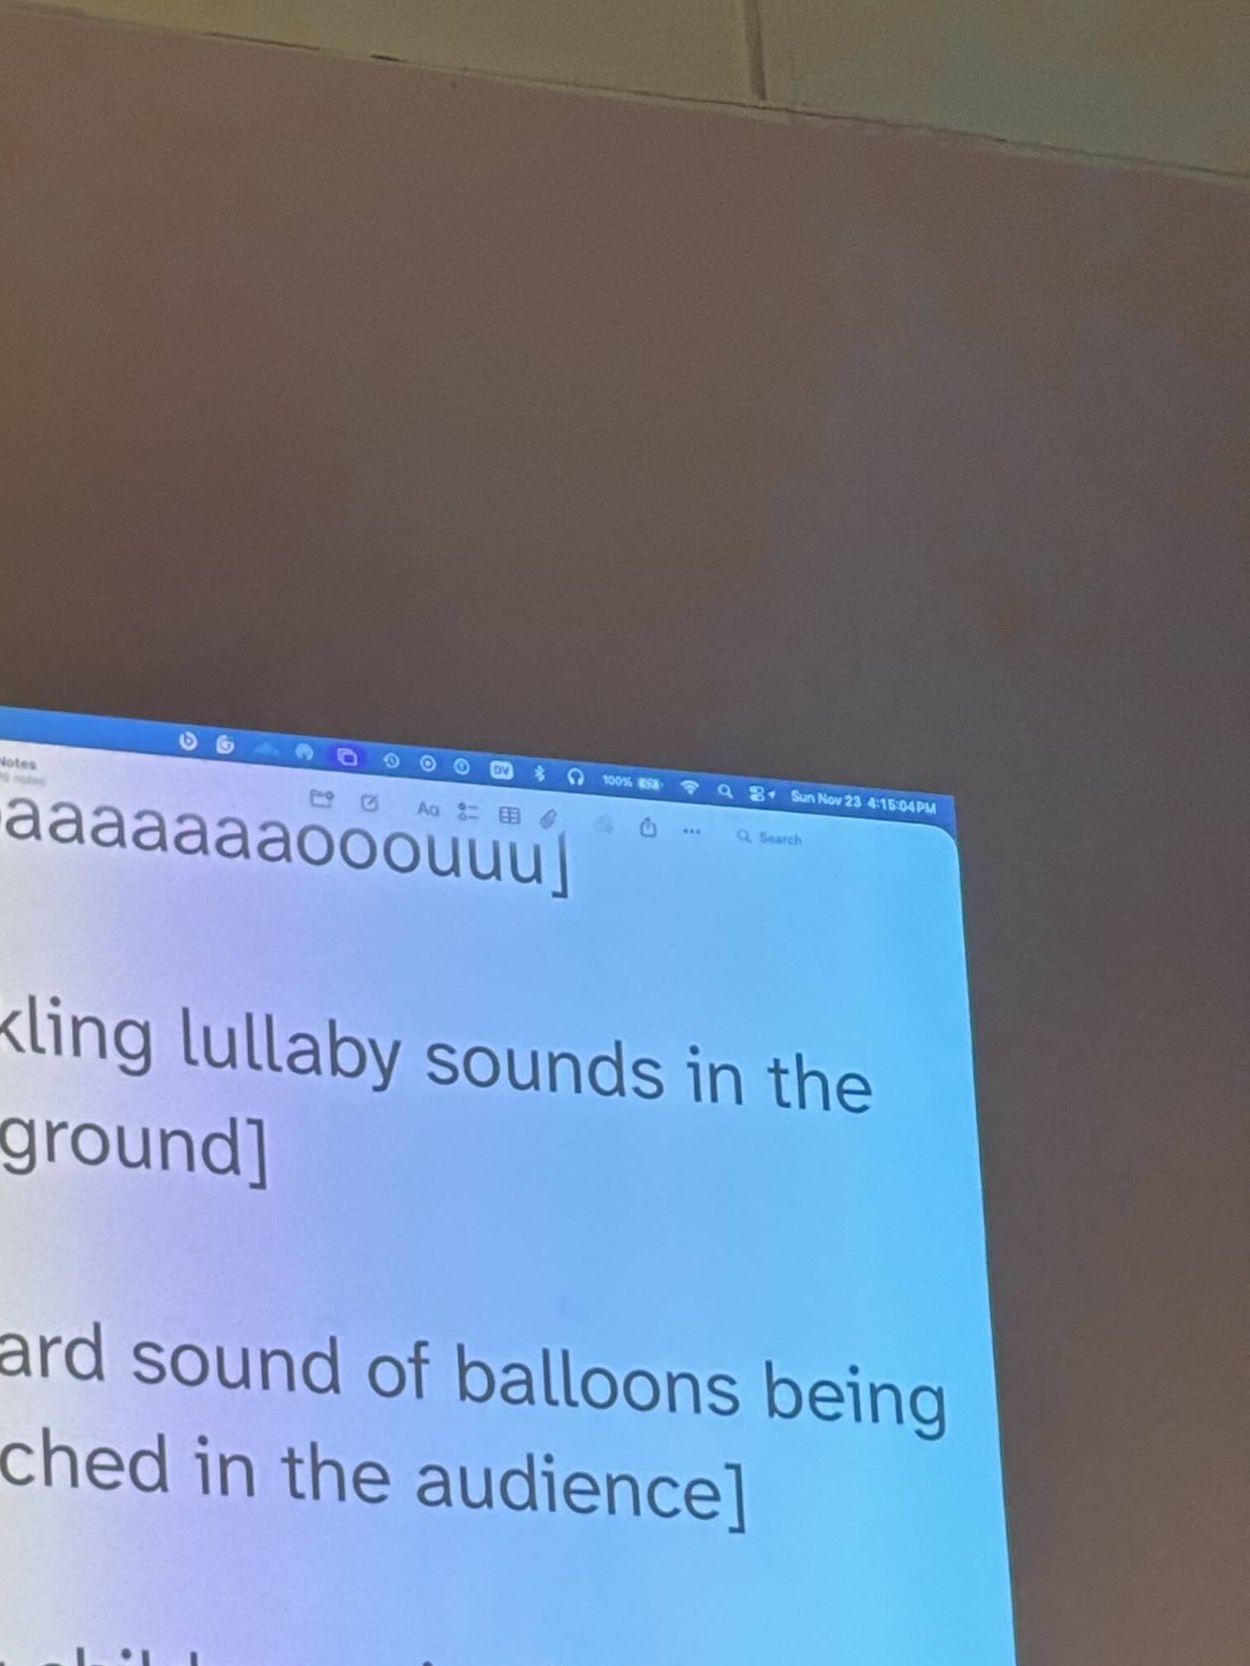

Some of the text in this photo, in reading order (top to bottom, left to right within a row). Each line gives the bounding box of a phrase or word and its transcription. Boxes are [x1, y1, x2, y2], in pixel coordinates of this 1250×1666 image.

[602, 774, 633, 788] 100%
[790, 789, 816, 803] Sun
[817, 792, 842, 807] Nov
[844, 794, 862, 808] 23
[758, 831, 803, 847] Search
[182, 1006, 401, 1092] lullaby
[426, 1039, 664, 1101] sounds
[686, 1045, 744, 1106] in
[767, 1052, 873, 1114] the
[132, 1335, 341, 1396] sound
[367, 1340, 430, 1400] of
[456, 1343, 740, 1417] balloons
[764, 1360, 946, 1441] being
[194, 1435, 255, 1498] in
[280, 1441, 391, 1504] the
[417, 1452, 746, 1535] audience]
